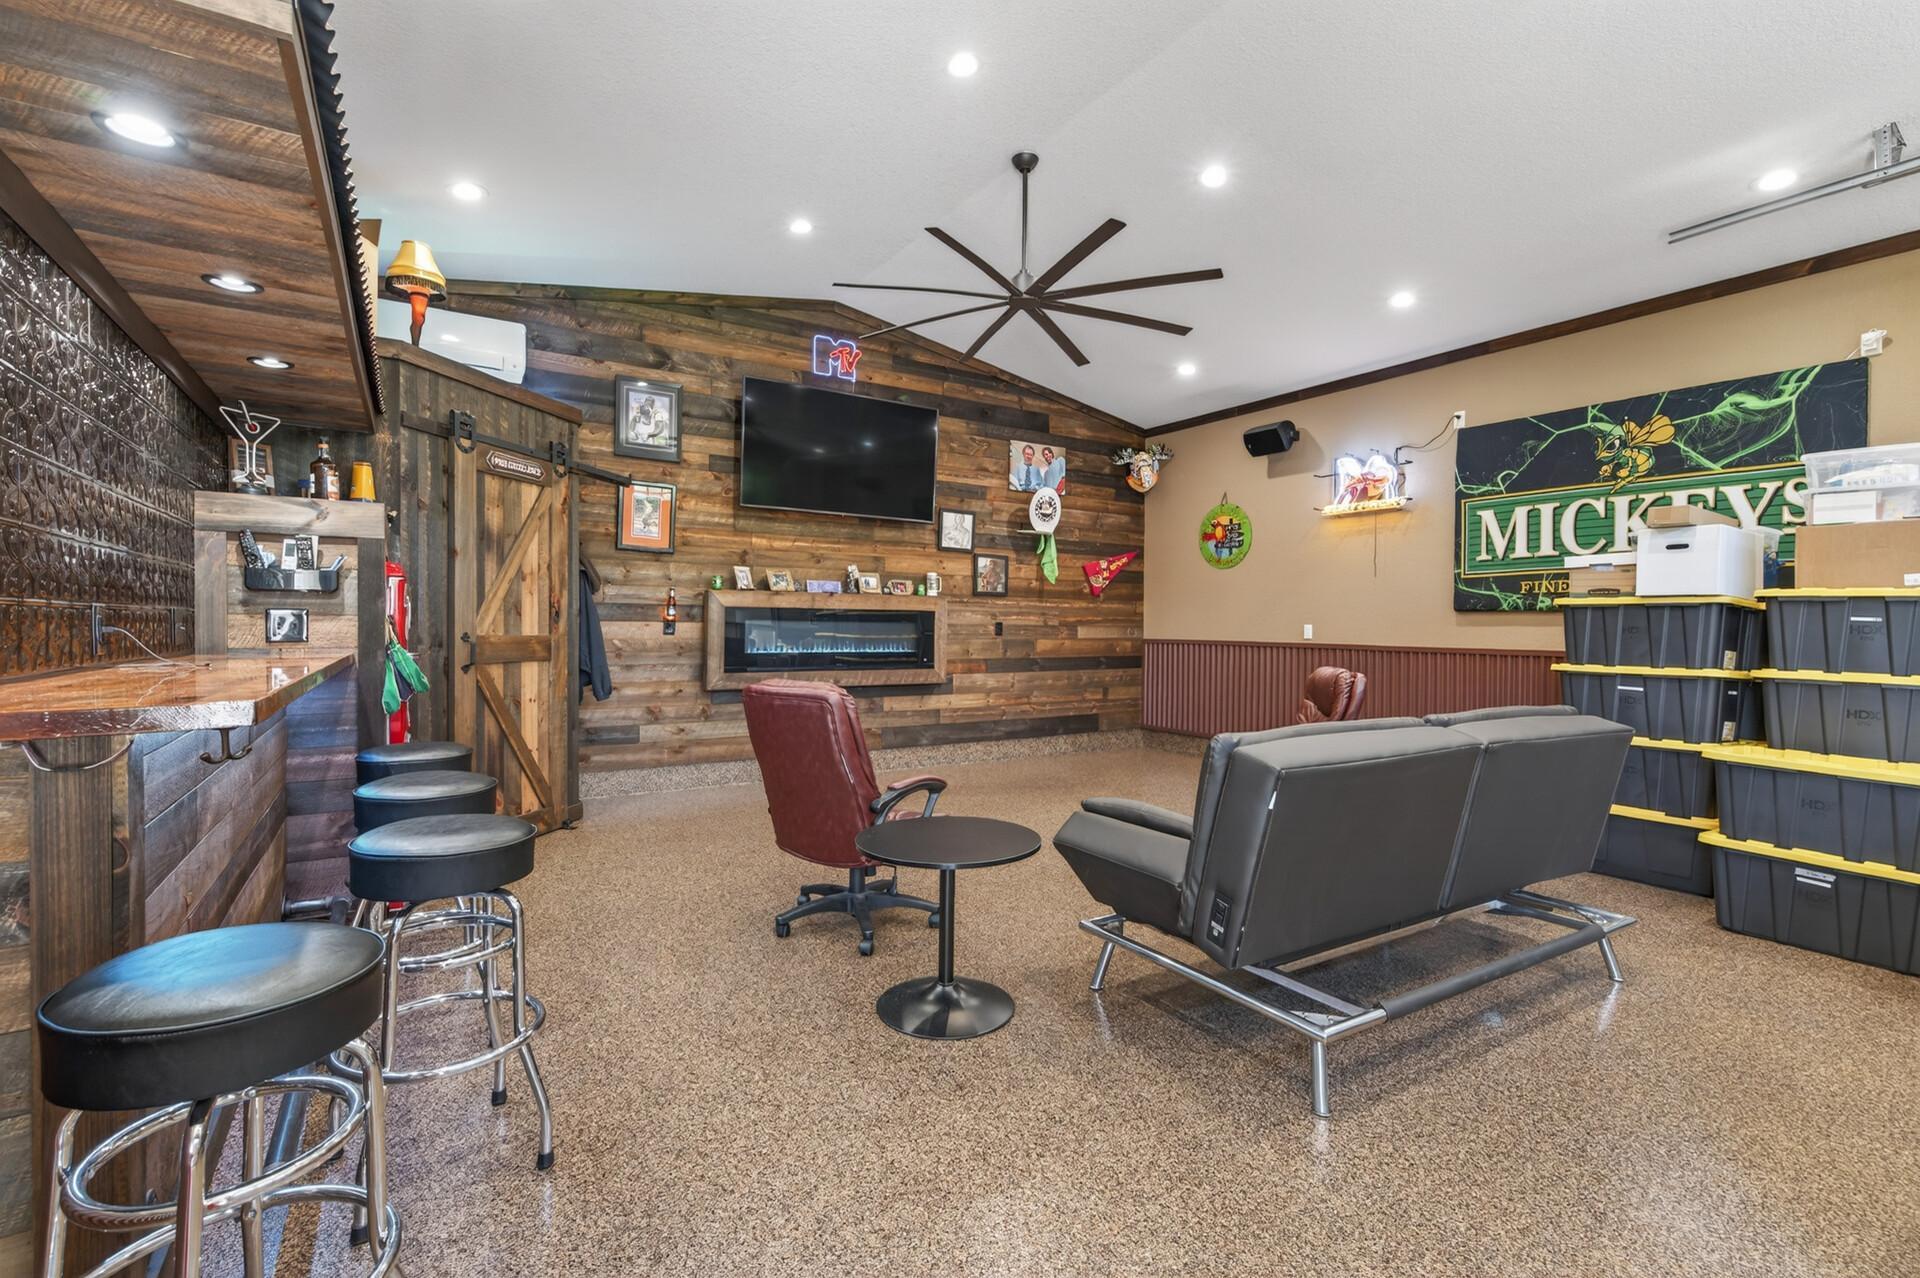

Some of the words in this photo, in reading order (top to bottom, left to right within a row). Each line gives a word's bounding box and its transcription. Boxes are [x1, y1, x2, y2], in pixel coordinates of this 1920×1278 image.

[813, 334, 863, 381] MTV
[1520, 579, 1569, 595] FINE
[1846, 708, 1881, 721] HDX
